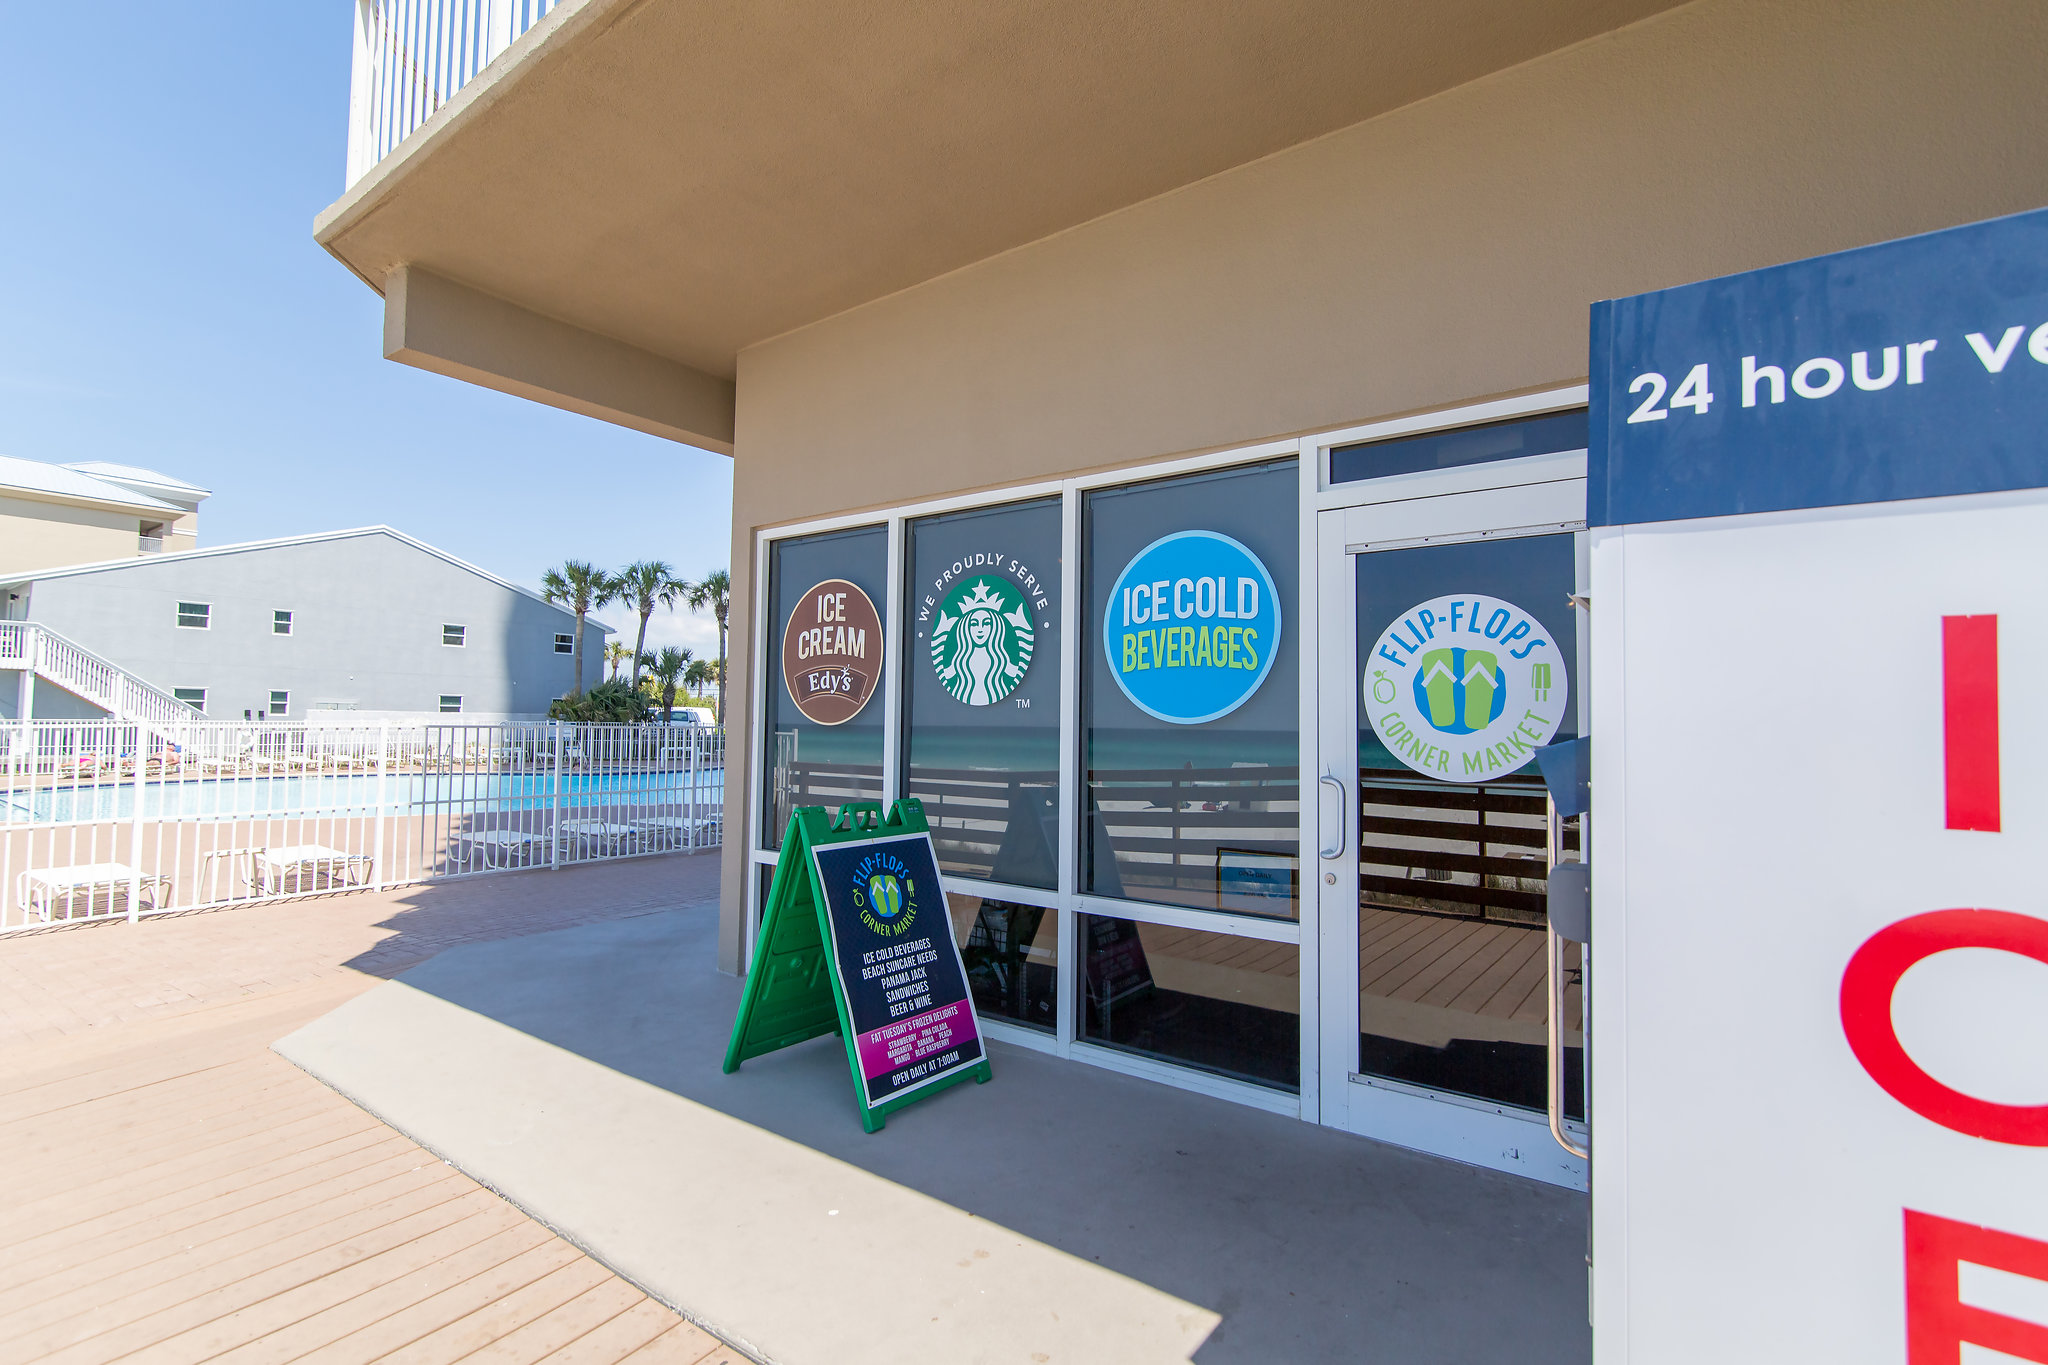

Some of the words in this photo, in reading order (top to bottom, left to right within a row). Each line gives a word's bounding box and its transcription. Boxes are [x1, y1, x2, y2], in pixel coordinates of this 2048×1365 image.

[1627, 363, 1713, 424] 24
[1742, 338, 1939, 408] hour
[918, 595, 936, 622] WE
[935, 552, 1004, 591] PROUDLY
[1008, 559, 1048, 610] SERVE
[1123, 580, 1170, 627] ICE
[1173, 576, 1259, 620] COLD
[817, 592, 847, 623] ICE
[798, 626, 866, 660] CREAM
[1122, 625, 1259, 673] BEVERAGES
[1379, 601, 1546, 667] FLIP-FLOPS
[808, 665, 852, 694] Edy's
[1016, 699, 1030, 709] TM
[1380, 712, 1450, 773] CORNER
[1462, 709, 1550, 775] MARKET
[853, 852, 910, 887] FLIP-FLOPS
[860, 909, 891, 937] CORNER
[893, 900, 918, 937] MARKET
[862, 963, 886, 980] BEACH
[885, 955, 917, 974] SUNCARE
[916, 949, 938, 965] NEEDS
[863, 951, 876, 965] ICE
[875, 947, 894, 962] COLD
[893, 937, 931, 957] BEVERAGES
[881, 971, 911, 990] PANAMA
[910, 966, 928, 981] JACK
[886, 980, 930, 1003] SANDWICHES
[889, 1001, 909, 1017] BEER
[908, 999, 915, 1011] &
[914, 994, 933, 1009] WINE
[870, 1032, 882, 1044] FAT
[881, 1021, 913, 1040] TUESDAY'S
[912, 1014, 934, 1030] FROZEN
[933, 1005, 959, 1022] DELIGHTS
[888, 1033, 917, 1050] STRAWBERRY
[931, 1022, 948, 1034] COLADA
[887, 1043, 913, 1059] MARGARITA
[916, 1035, 935, 1048] BANANA
[938, 1028, 953, 1040] PEACH
[894, 1052, 911, 1065] MANGO
[914, 1047, 927, 1058] BLUE
[926, 1038, 950, 1054] RASPBERRY
[892, 1070, 910, 1086] OPEN
[909, 1063, 928, 1079] DAILY
[928, 1059, 937, 1072] AT
[936, 1050, 960, 1068] 7:00AM
